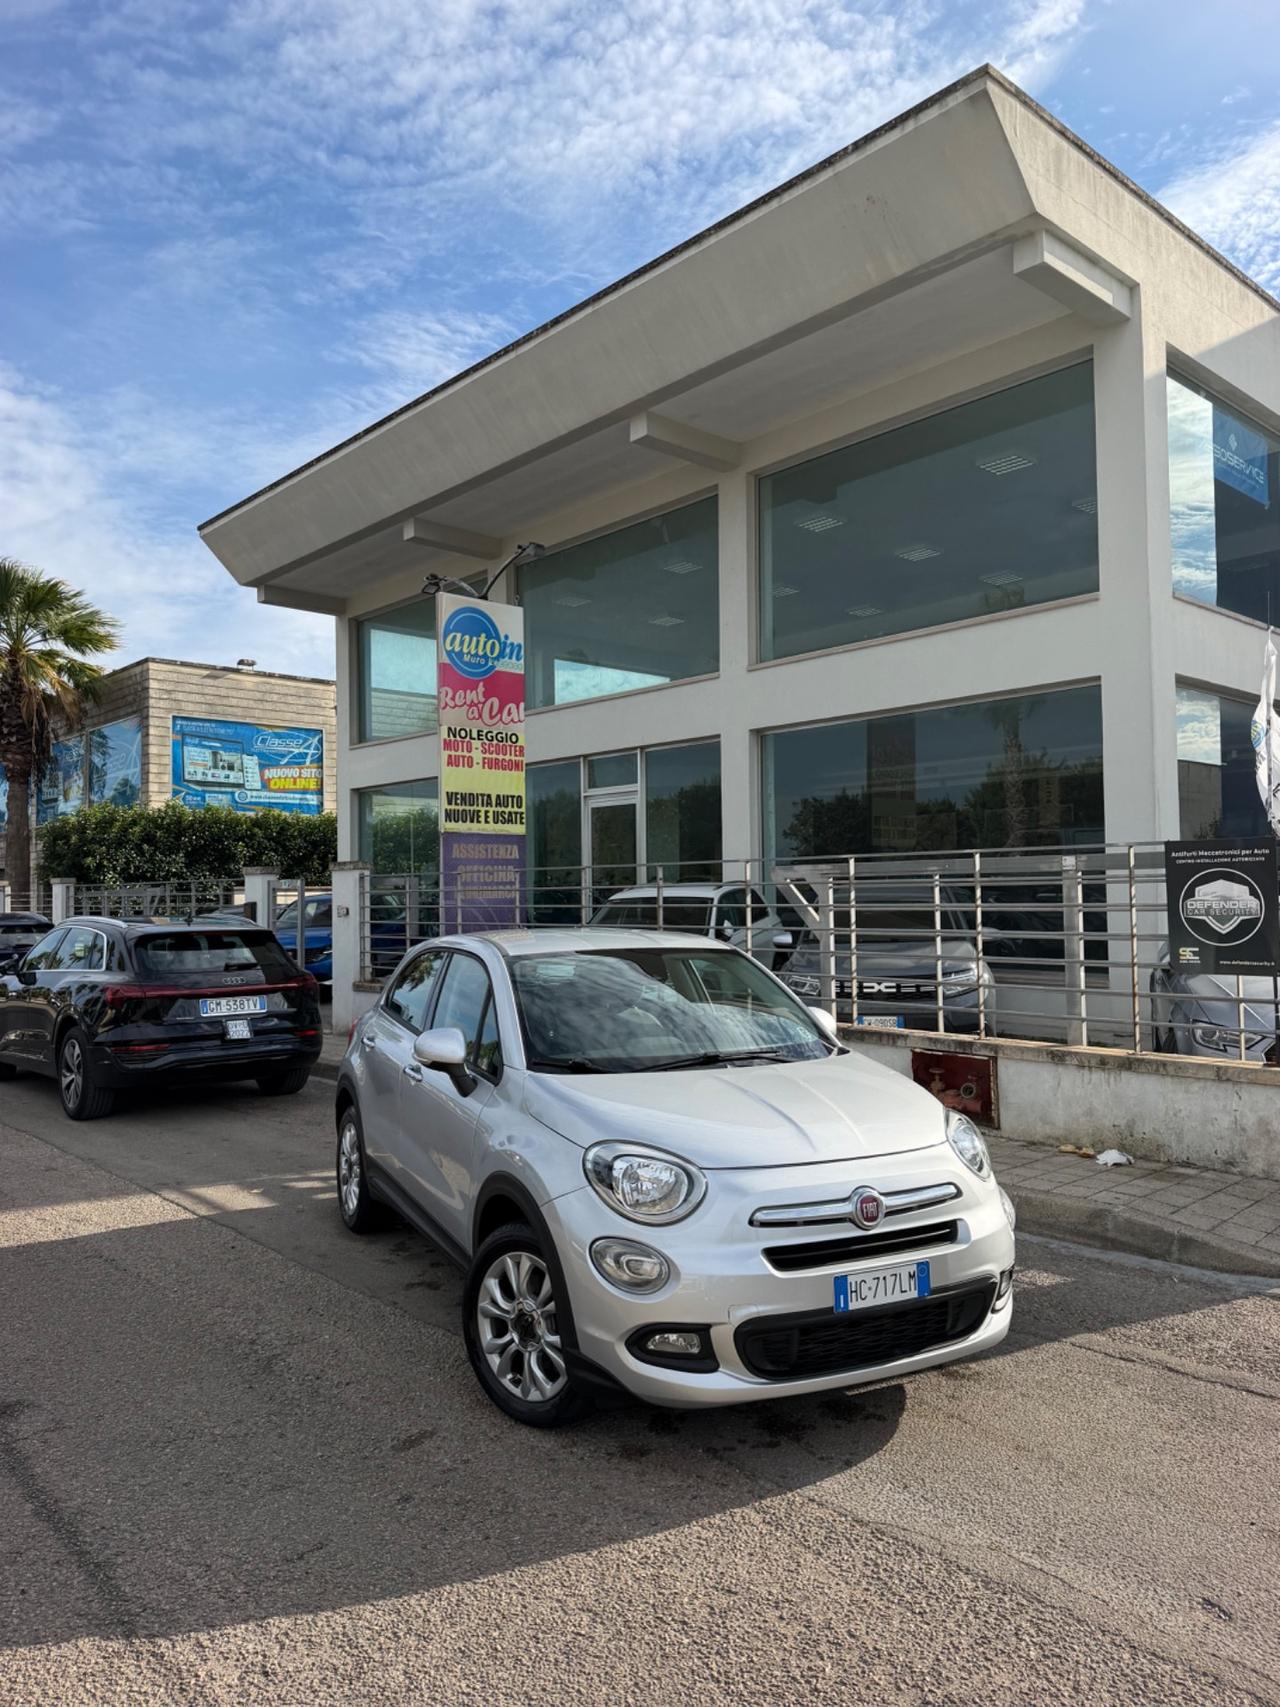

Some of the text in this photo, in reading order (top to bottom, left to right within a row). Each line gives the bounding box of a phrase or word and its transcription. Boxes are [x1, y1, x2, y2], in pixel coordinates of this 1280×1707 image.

[463, 654, 486, 665] Muro
[439, 682, 486, 708] Rent
[256, 735, 303, 748] Classe
[447, 727, 519, 744] NOLEGGIO
[443, 739, 473, 753] MOTO
[481, 742, 525, 758] SCOOTER
[447, 754, 474, 768] AUTO
[482, 757, 524, 772] FURGONI
[264, 767, 322, 779] NUOVO SITO
[446, 792, 523, 809] VENDITA AUTO
[444, 808, 525, 825] NUOVE E USATE
[452, 843, 519, 859] ASSISTENZA
[1241, 849, 1252, 857] per
[1253, 847, 1270, 855] Auto
[1187, 900, 1258, 909] DEFENDER
[1209, 908, 1257, 916] SECURITY
[863, 1202, 878, 1218] FIAT
